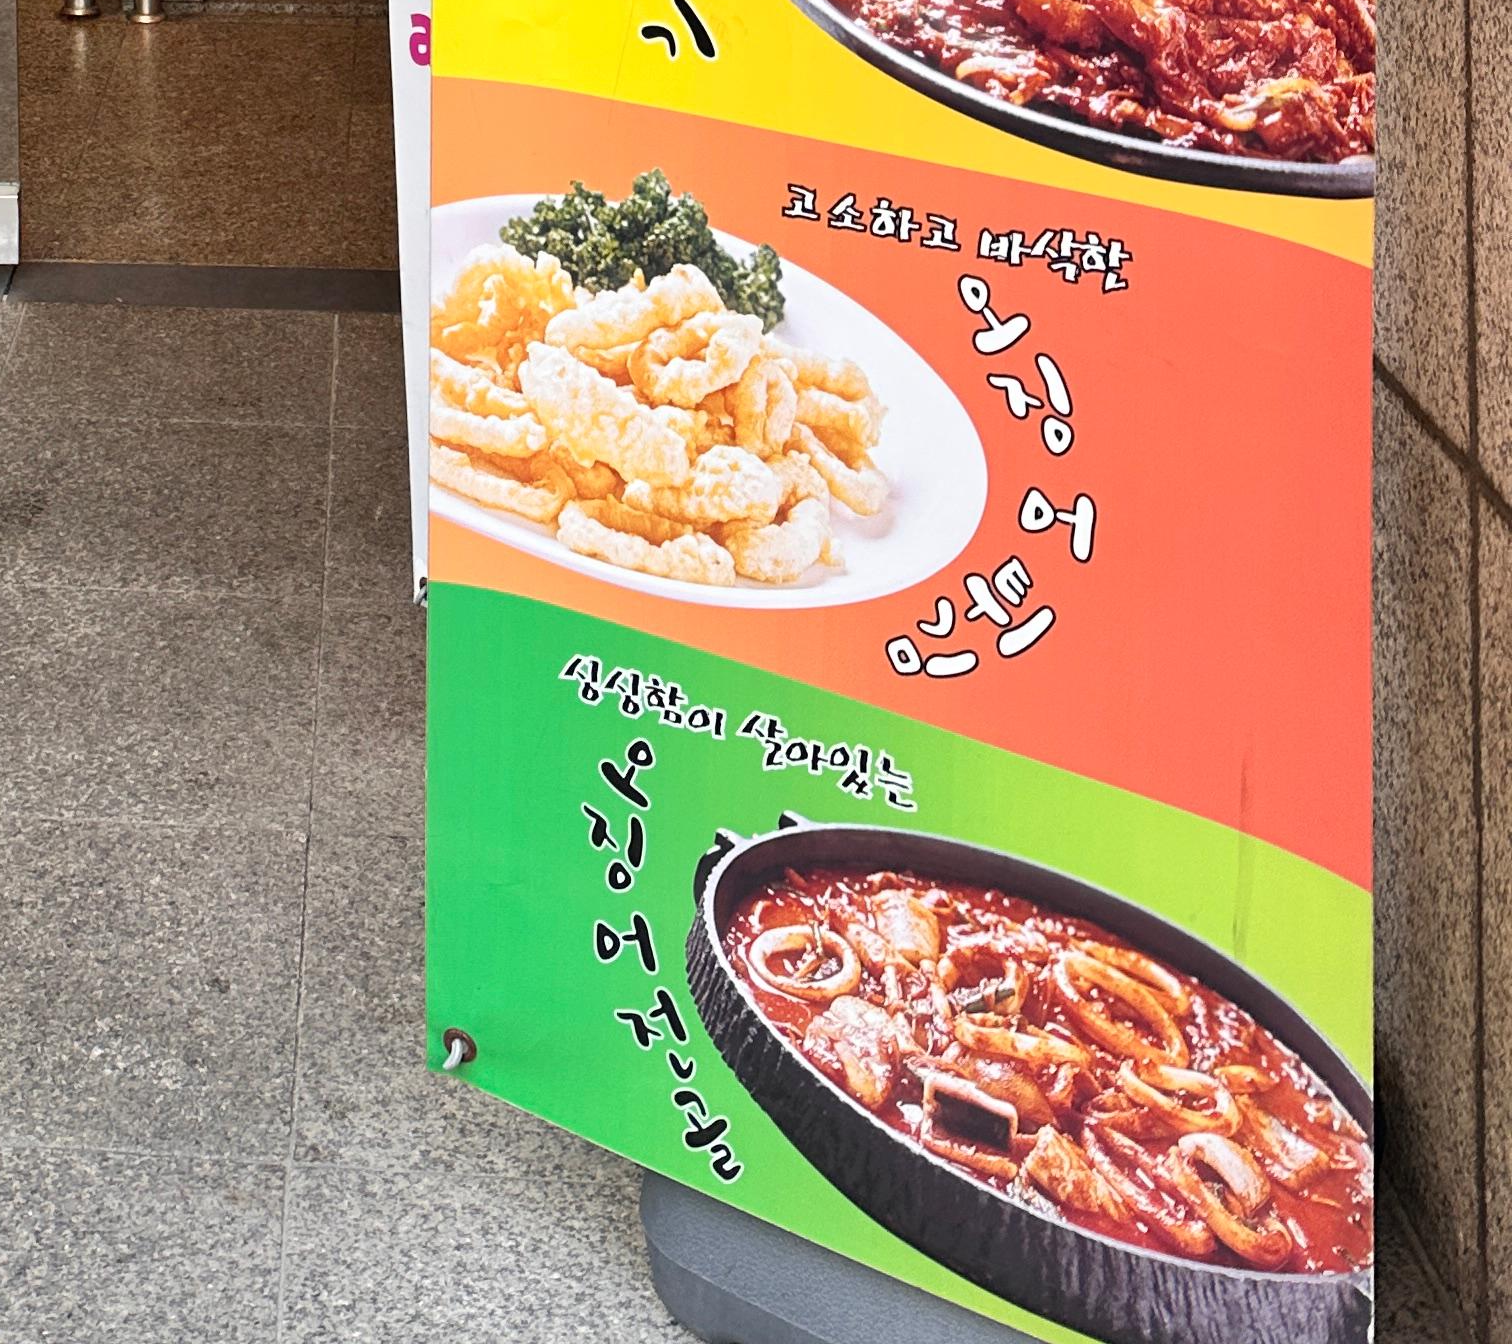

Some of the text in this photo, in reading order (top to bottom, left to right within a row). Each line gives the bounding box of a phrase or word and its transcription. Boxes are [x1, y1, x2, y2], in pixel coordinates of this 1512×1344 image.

[782, 184, 1133, 293] 고소하고 바삭한
[886, 273, 1097, 678] 오징어튀김
[563, 657, 915, 809] 싱싱함이 살아있는
[584, 740, 742, 1182] 오징어전골
